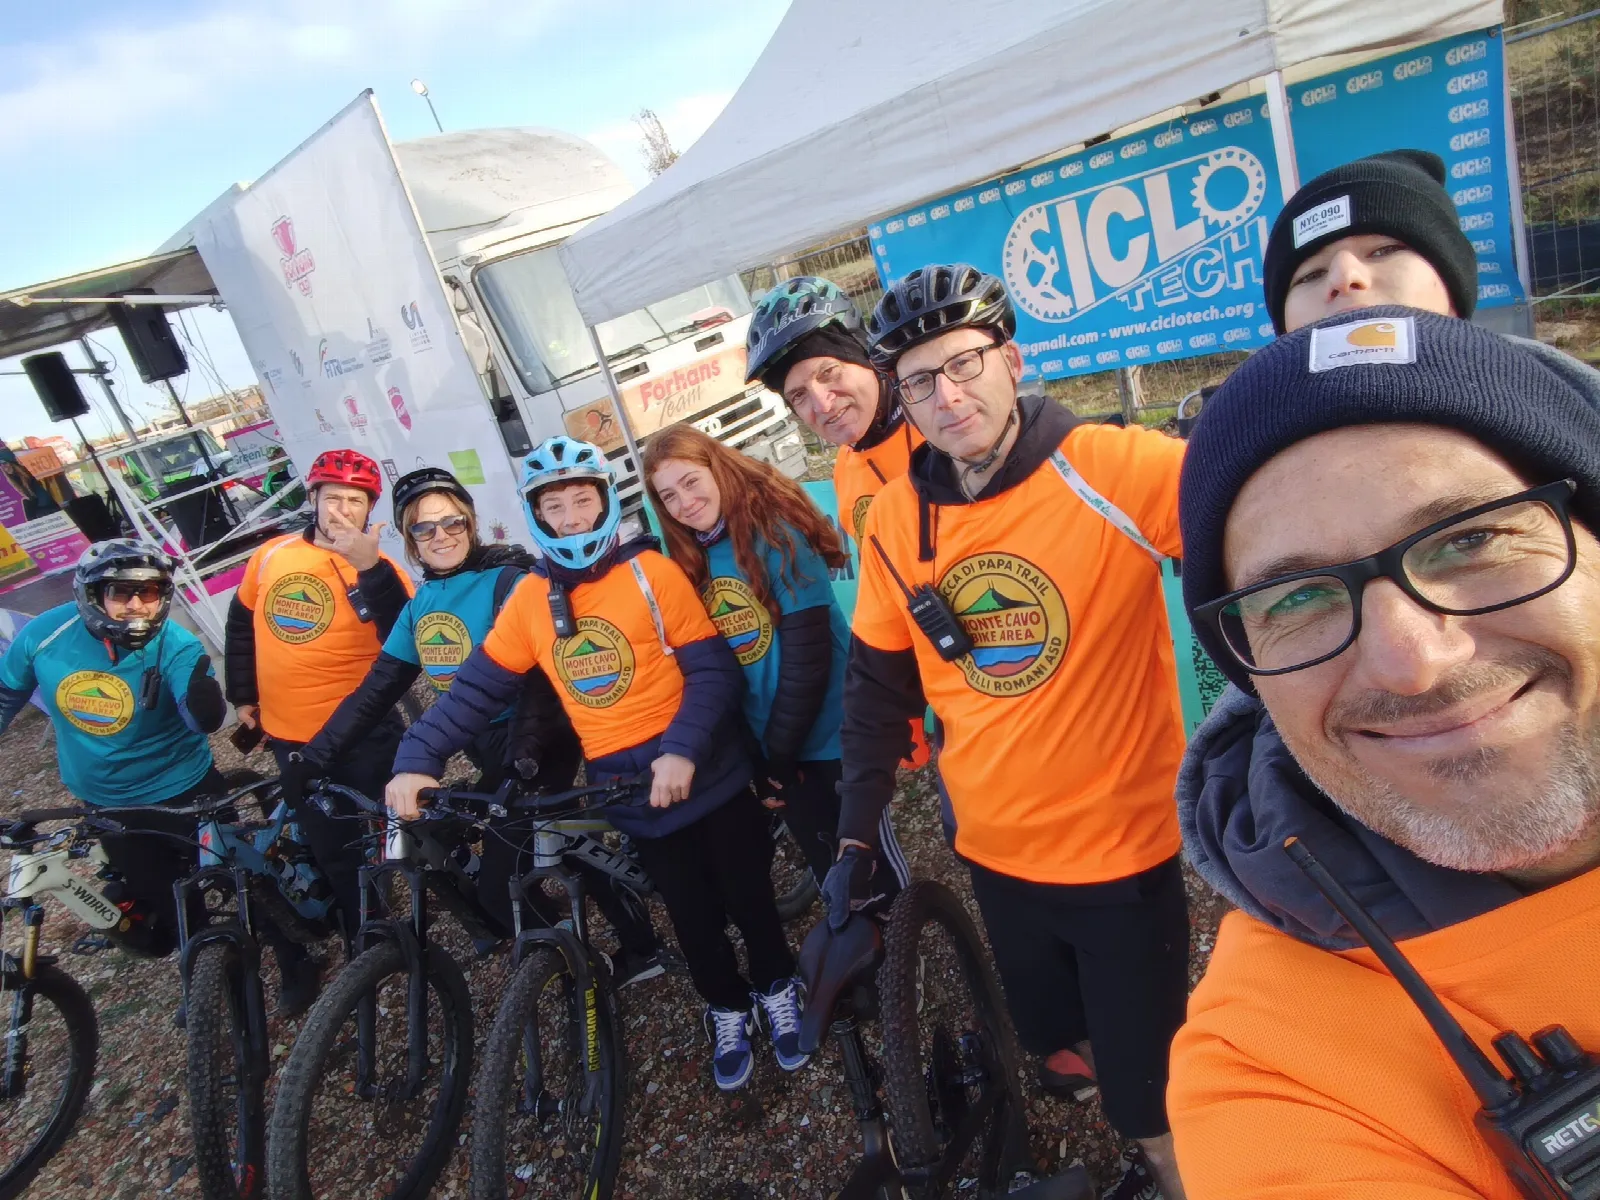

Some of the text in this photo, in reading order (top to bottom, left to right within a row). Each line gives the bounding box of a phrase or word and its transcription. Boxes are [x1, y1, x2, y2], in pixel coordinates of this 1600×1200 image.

[1445, 40, 1487, 66] CICLO
[1393, 56, 1432, 81] CICLO
[1346, 70, 1382, 94] CICLO
[1447, 70, 1488, 94] CICLO
[1301, 84, 1336, 107] CICLO
[1223, 109, 1252, 128] CICLO
[1448, 99, 1488, 123] CICLO
[1189, 119, 1216, 137] CICLO
[1120, 140, 1146, 159] CICLO
[1449, 128, 1490, 151] CICLO
[1451, 156, 1491, 178] CICLO
[1453, 185, 1492, 206] CICLO
[1300, 213, 1319, 230] NYC
[1321, 205, 1340, 219] 090
[1002, 146, 1266, 323] CICLO
[1473, 239, 1496, 253] CLO
[1116, 215, 1268, 312] TECH
[1109, 302, 1254, 339] www.ciclotech.org
[639, 358, 721, 412] Forhans
[944, 558, 1050, 600] CCA DI PAPA TRAIL
[276, 599, 321, 614] MONTE CAVO
[295, 611, 315, 621] AREA
[715, 610, 754, 629] ONTE CAVO
[733, 621, 753, 632] AREA
[1005, 611, 1041, 627] CAVO
[579, 620, 599, 629] PAPA
[600, 622, 621, 643] TRAIL
[762, 623, 770, 641] ASD
[972, 629, 1035, 643] BIKE AREA
[443, 646, 461, 656] CAVO
[565, 653, 617, 671] MONTE CAVO
[572, 665, 614, 678] BIKE AREA
[960, 636, 1062, 691] ASTELLI ROMANI ASD
[596, 684, 625, 705] ROMANI
[623, 666, 632, 684] ASD
[98, 699, 120, 709] CAVO
[62, 878, 118, 922] S-WORKS
